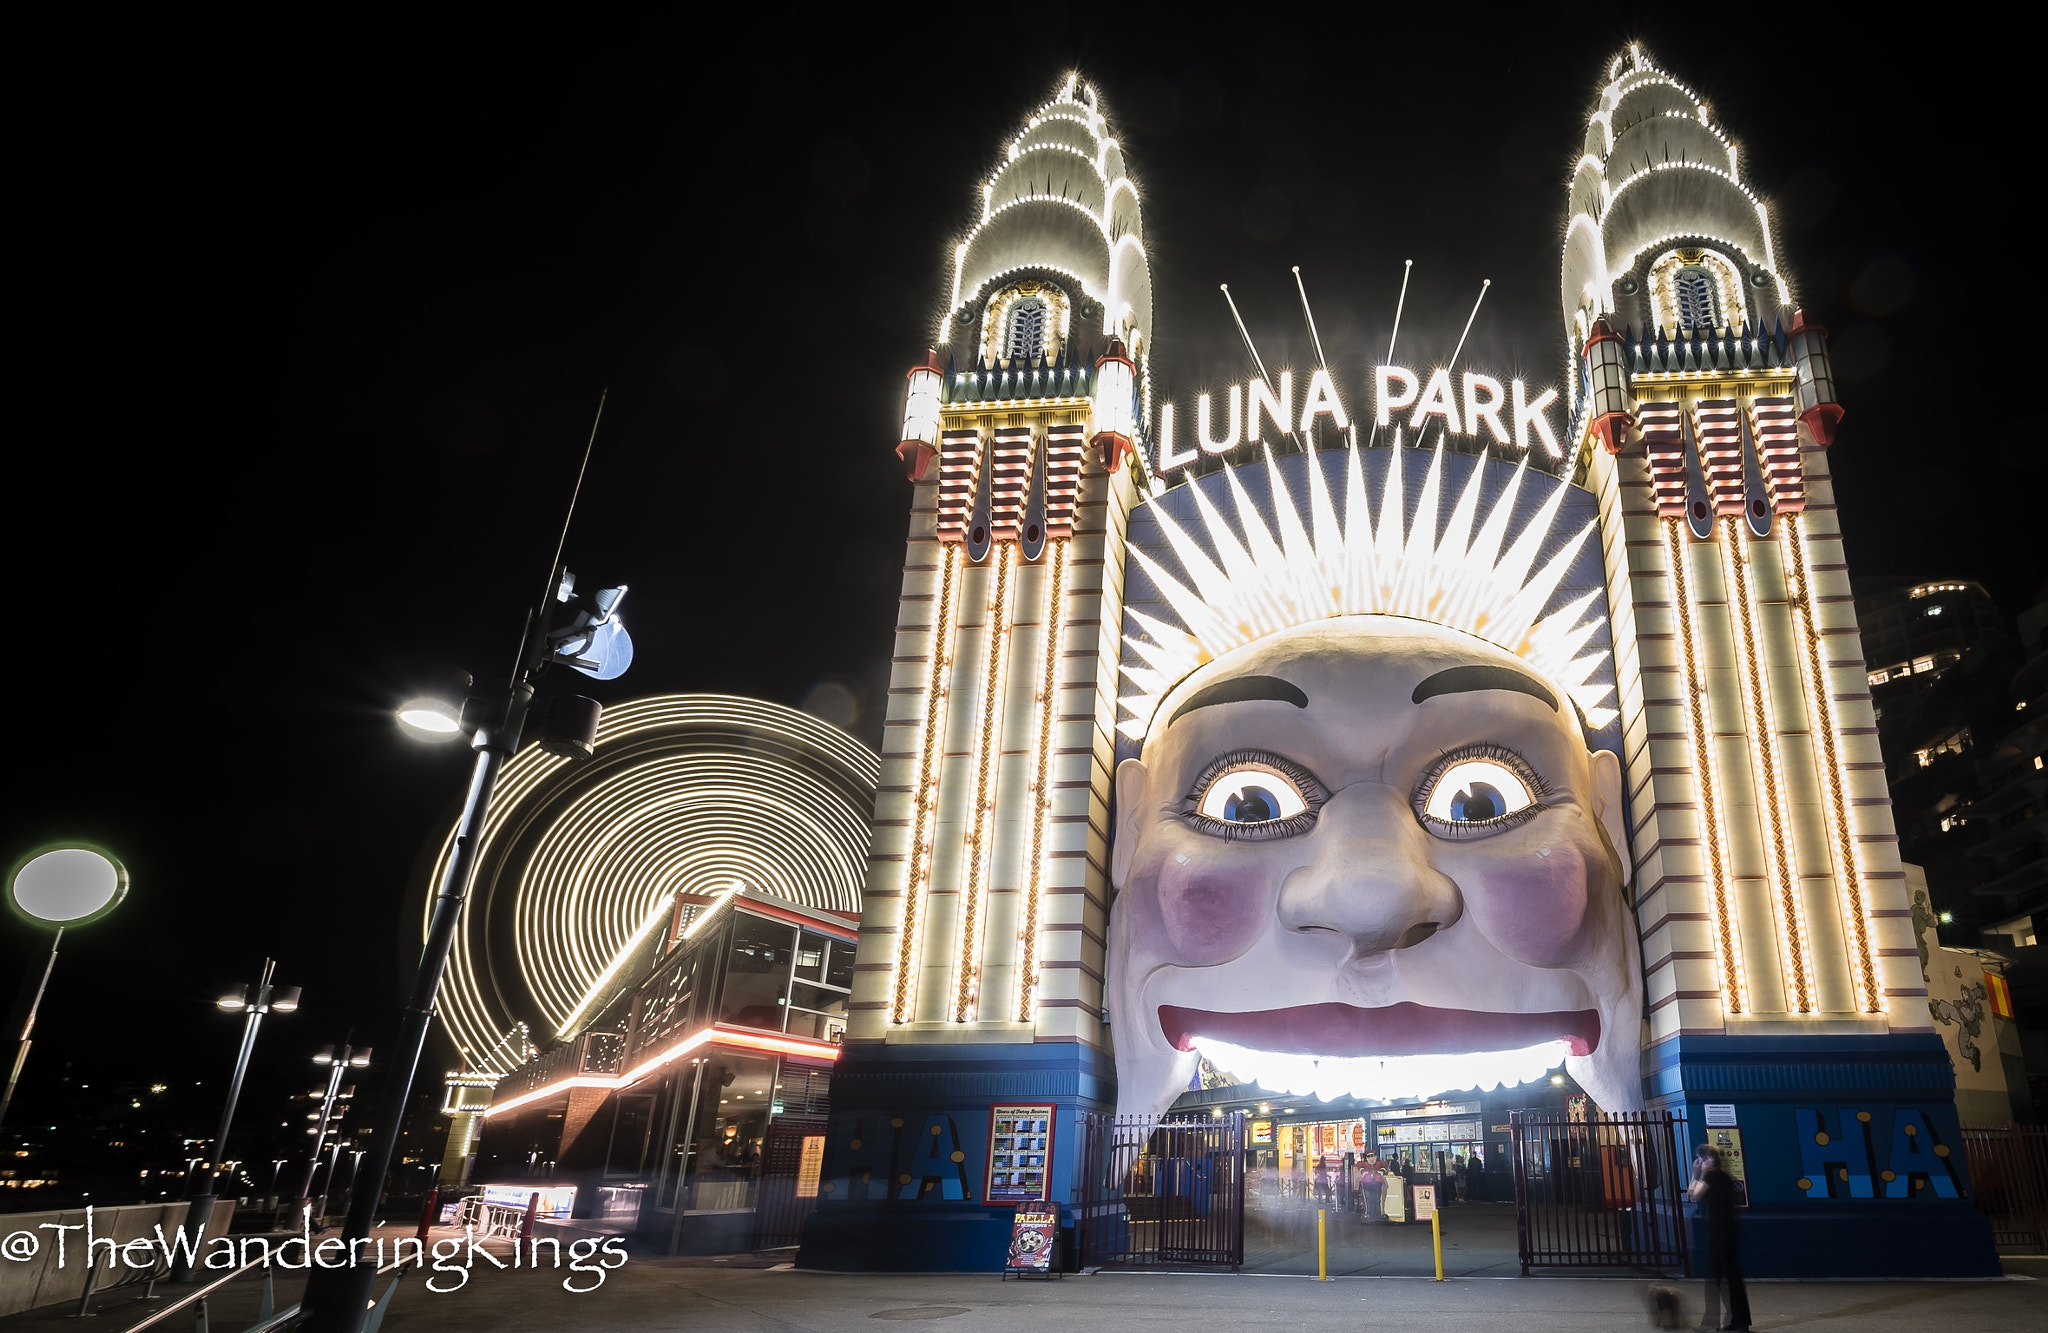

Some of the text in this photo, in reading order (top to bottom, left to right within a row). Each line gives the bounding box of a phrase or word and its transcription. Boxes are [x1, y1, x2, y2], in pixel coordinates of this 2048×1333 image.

[1160, 364, 1564, 473] LUNA PARK
[826, 1114, 972, 1201] HA
[1795, 1107, 1970, 1201] HA
[1014, 1213, 1056, 1224] PAELLA
